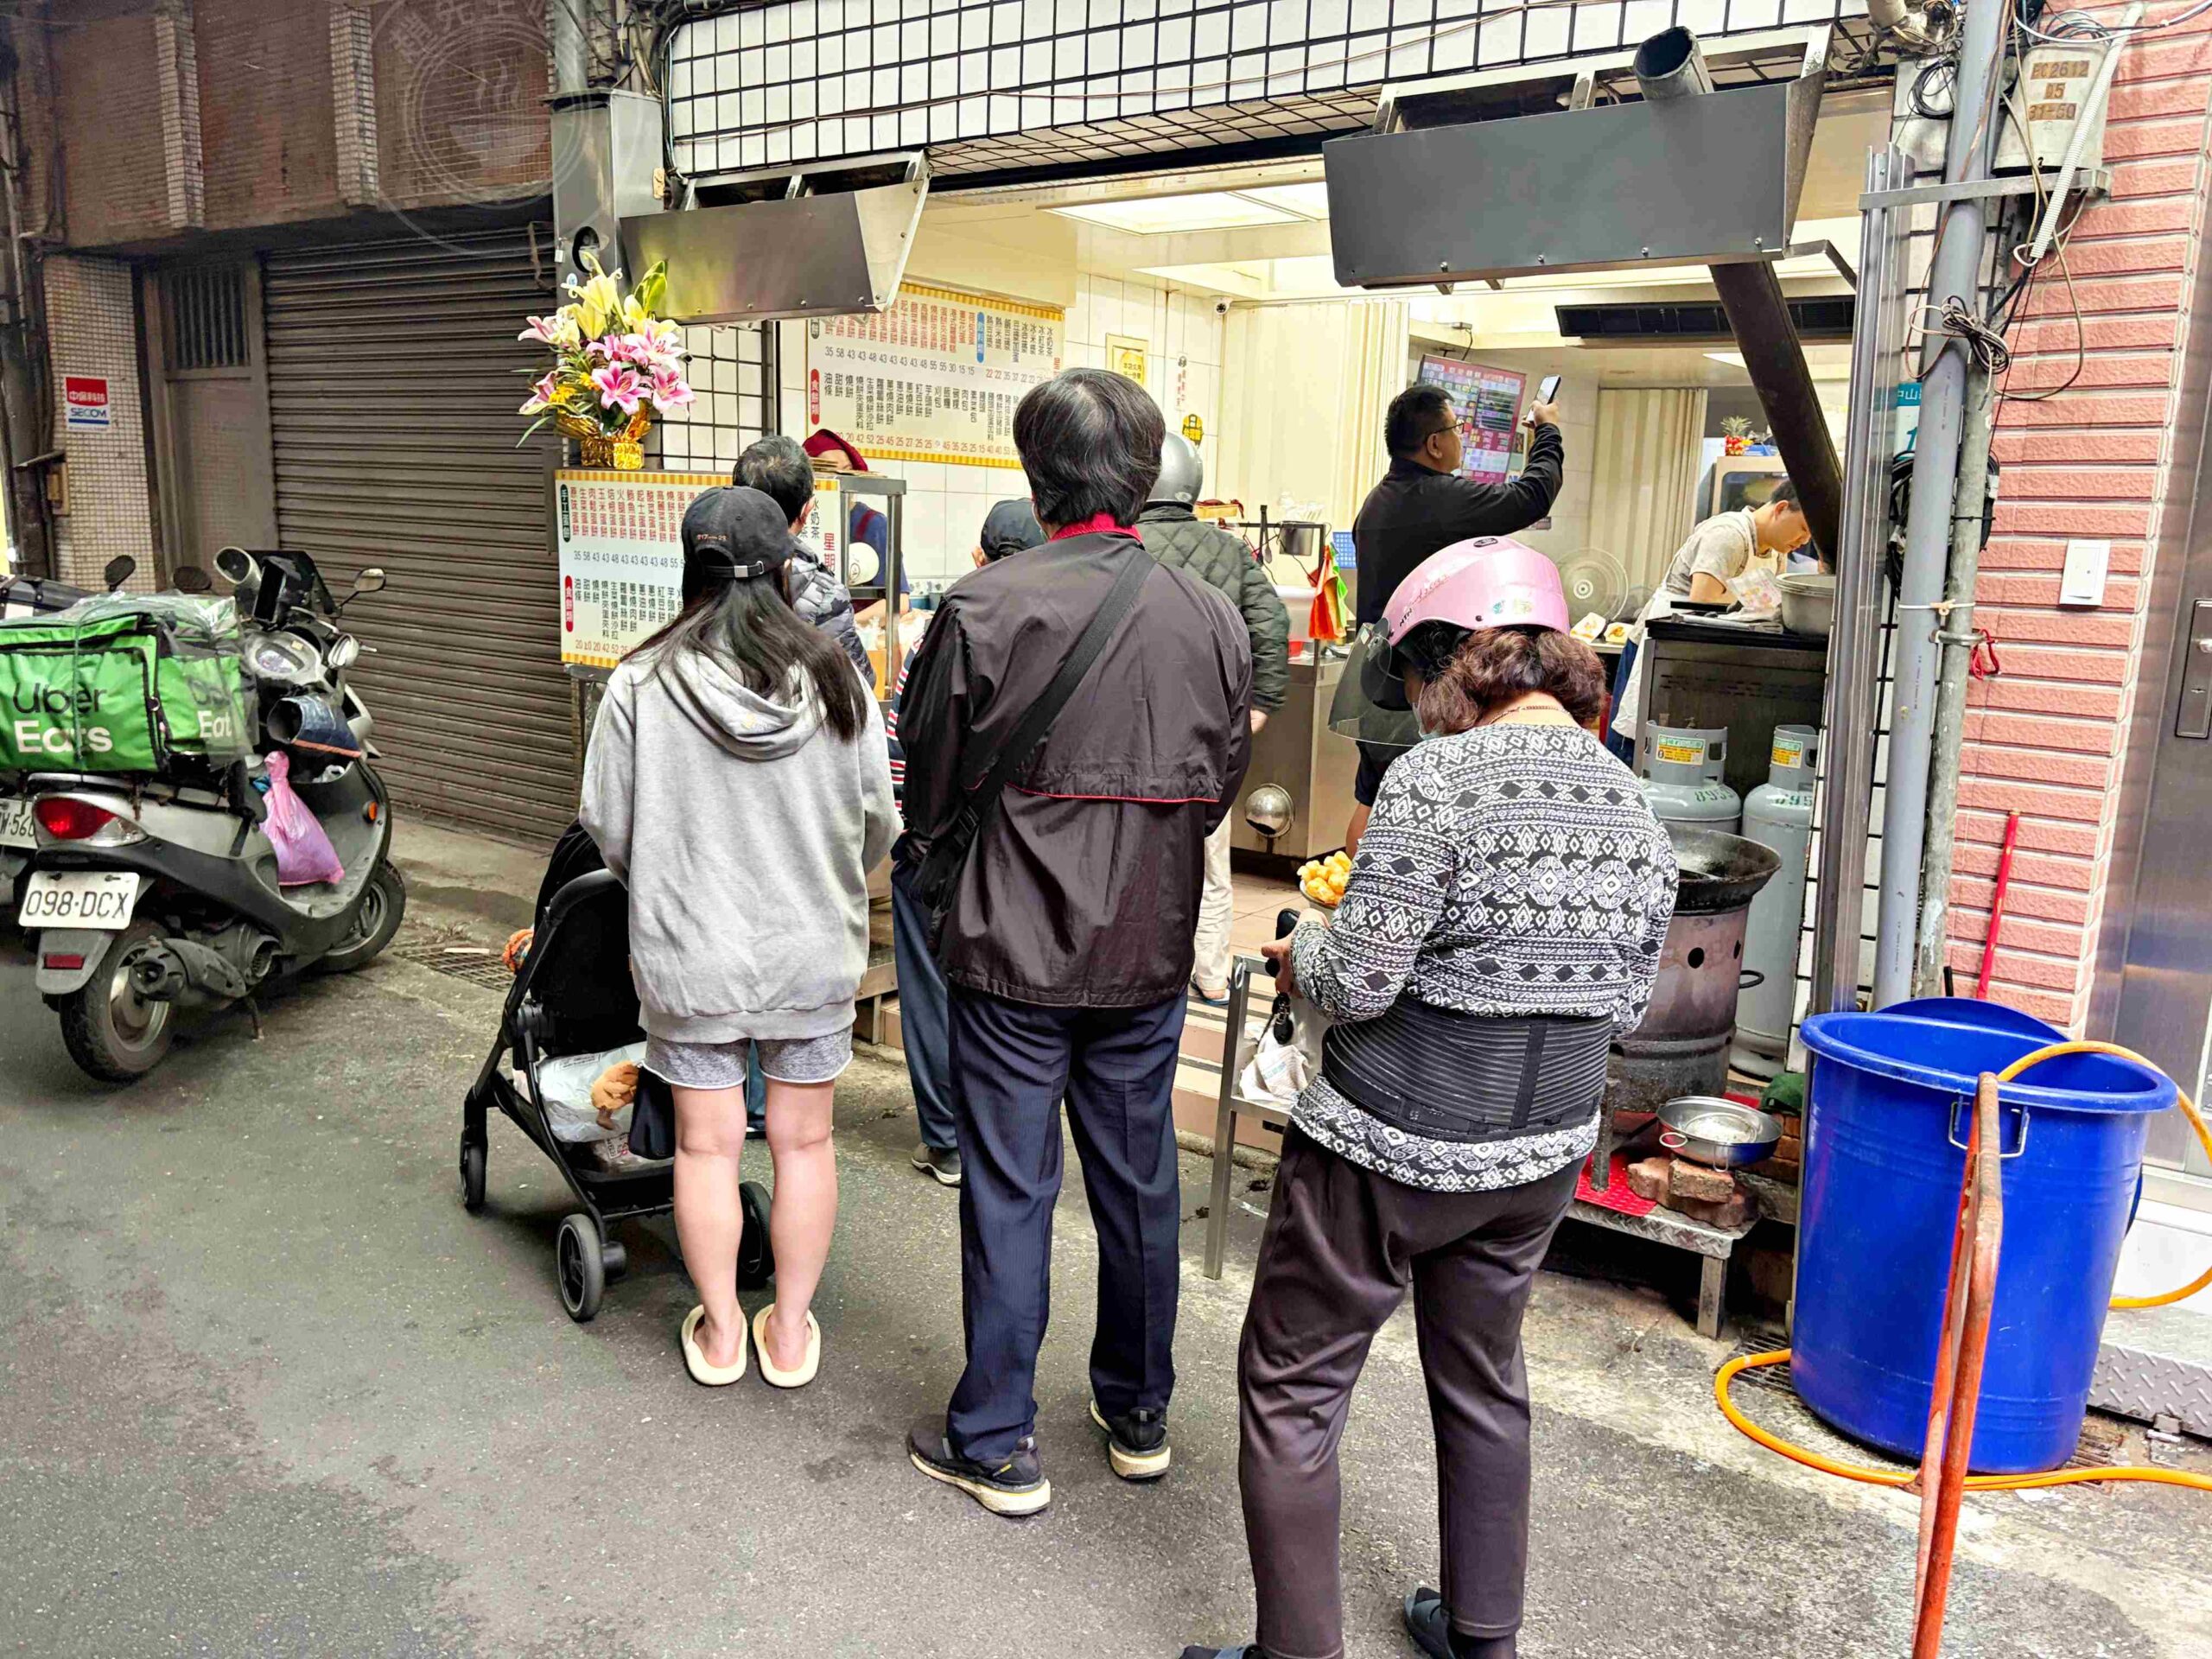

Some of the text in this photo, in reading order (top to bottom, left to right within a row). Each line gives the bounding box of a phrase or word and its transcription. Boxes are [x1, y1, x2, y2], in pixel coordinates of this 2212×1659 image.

[70, 407, 106, 418] SECOM
[574, 550, 582, 561] 35
[582, 551, 591, 562] 58
[592, 551, 600, 562] 43
[601, 553, 610, 563] 43
[611, 554, 620, 563] 48
[620, 554, 629, 564] 43
[631, 555, 639, 565] 43
[640, 556, 649, 566] 43
[650, 556, 658, 567] 43
[660, 557, 668, 568] 48
[670, 558, 678, 568] 55
[13, 682, 108, 714] Uber
[25, 890, 129, 918] 098·DCX
